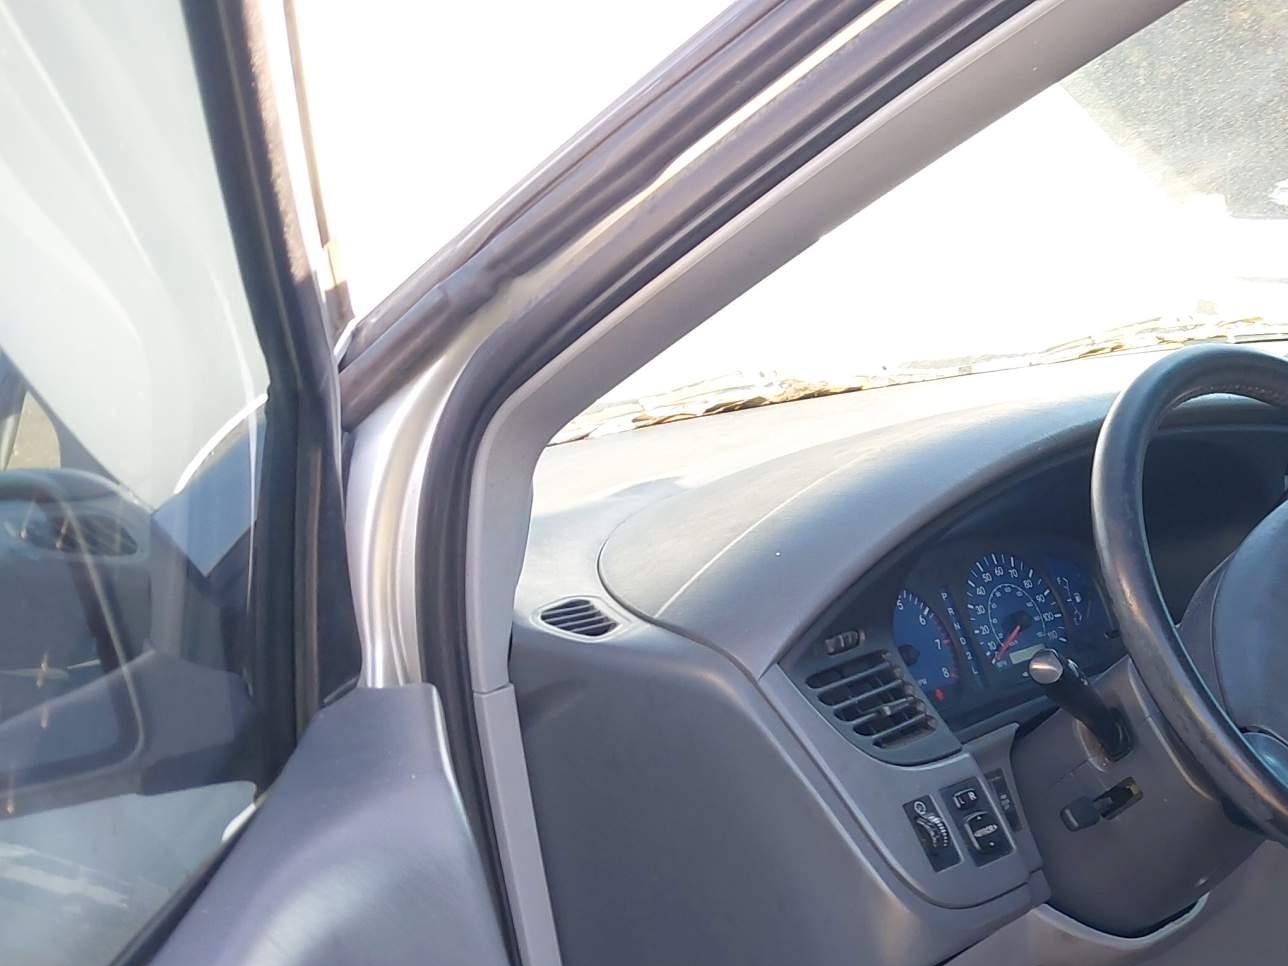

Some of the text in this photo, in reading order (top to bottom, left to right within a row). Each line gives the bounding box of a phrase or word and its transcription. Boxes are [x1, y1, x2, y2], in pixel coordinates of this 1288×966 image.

[994, 566, 1004, 576] 60
[1008, 568, 1018, 578] 70
[982, 572, 993, 582] 50
[941, 592, 948, 600] P
[896, 599, 904, 610] 5
[947, 607, 955, 615] R
[975, 605, 985, 615] 30
[919, 614, 926, 625] 6
[1043, 614, 1054, 622] 100
[980, 624, 990, 635] 20
[934, 639, 942, 650] 7
[987, 641, 997, 650] 10
[966, 651, 972, 660] 2
[942, 667, 950, 678] 8
[971, 664, 979, 674] L
[968, 791, 977, 800] R
